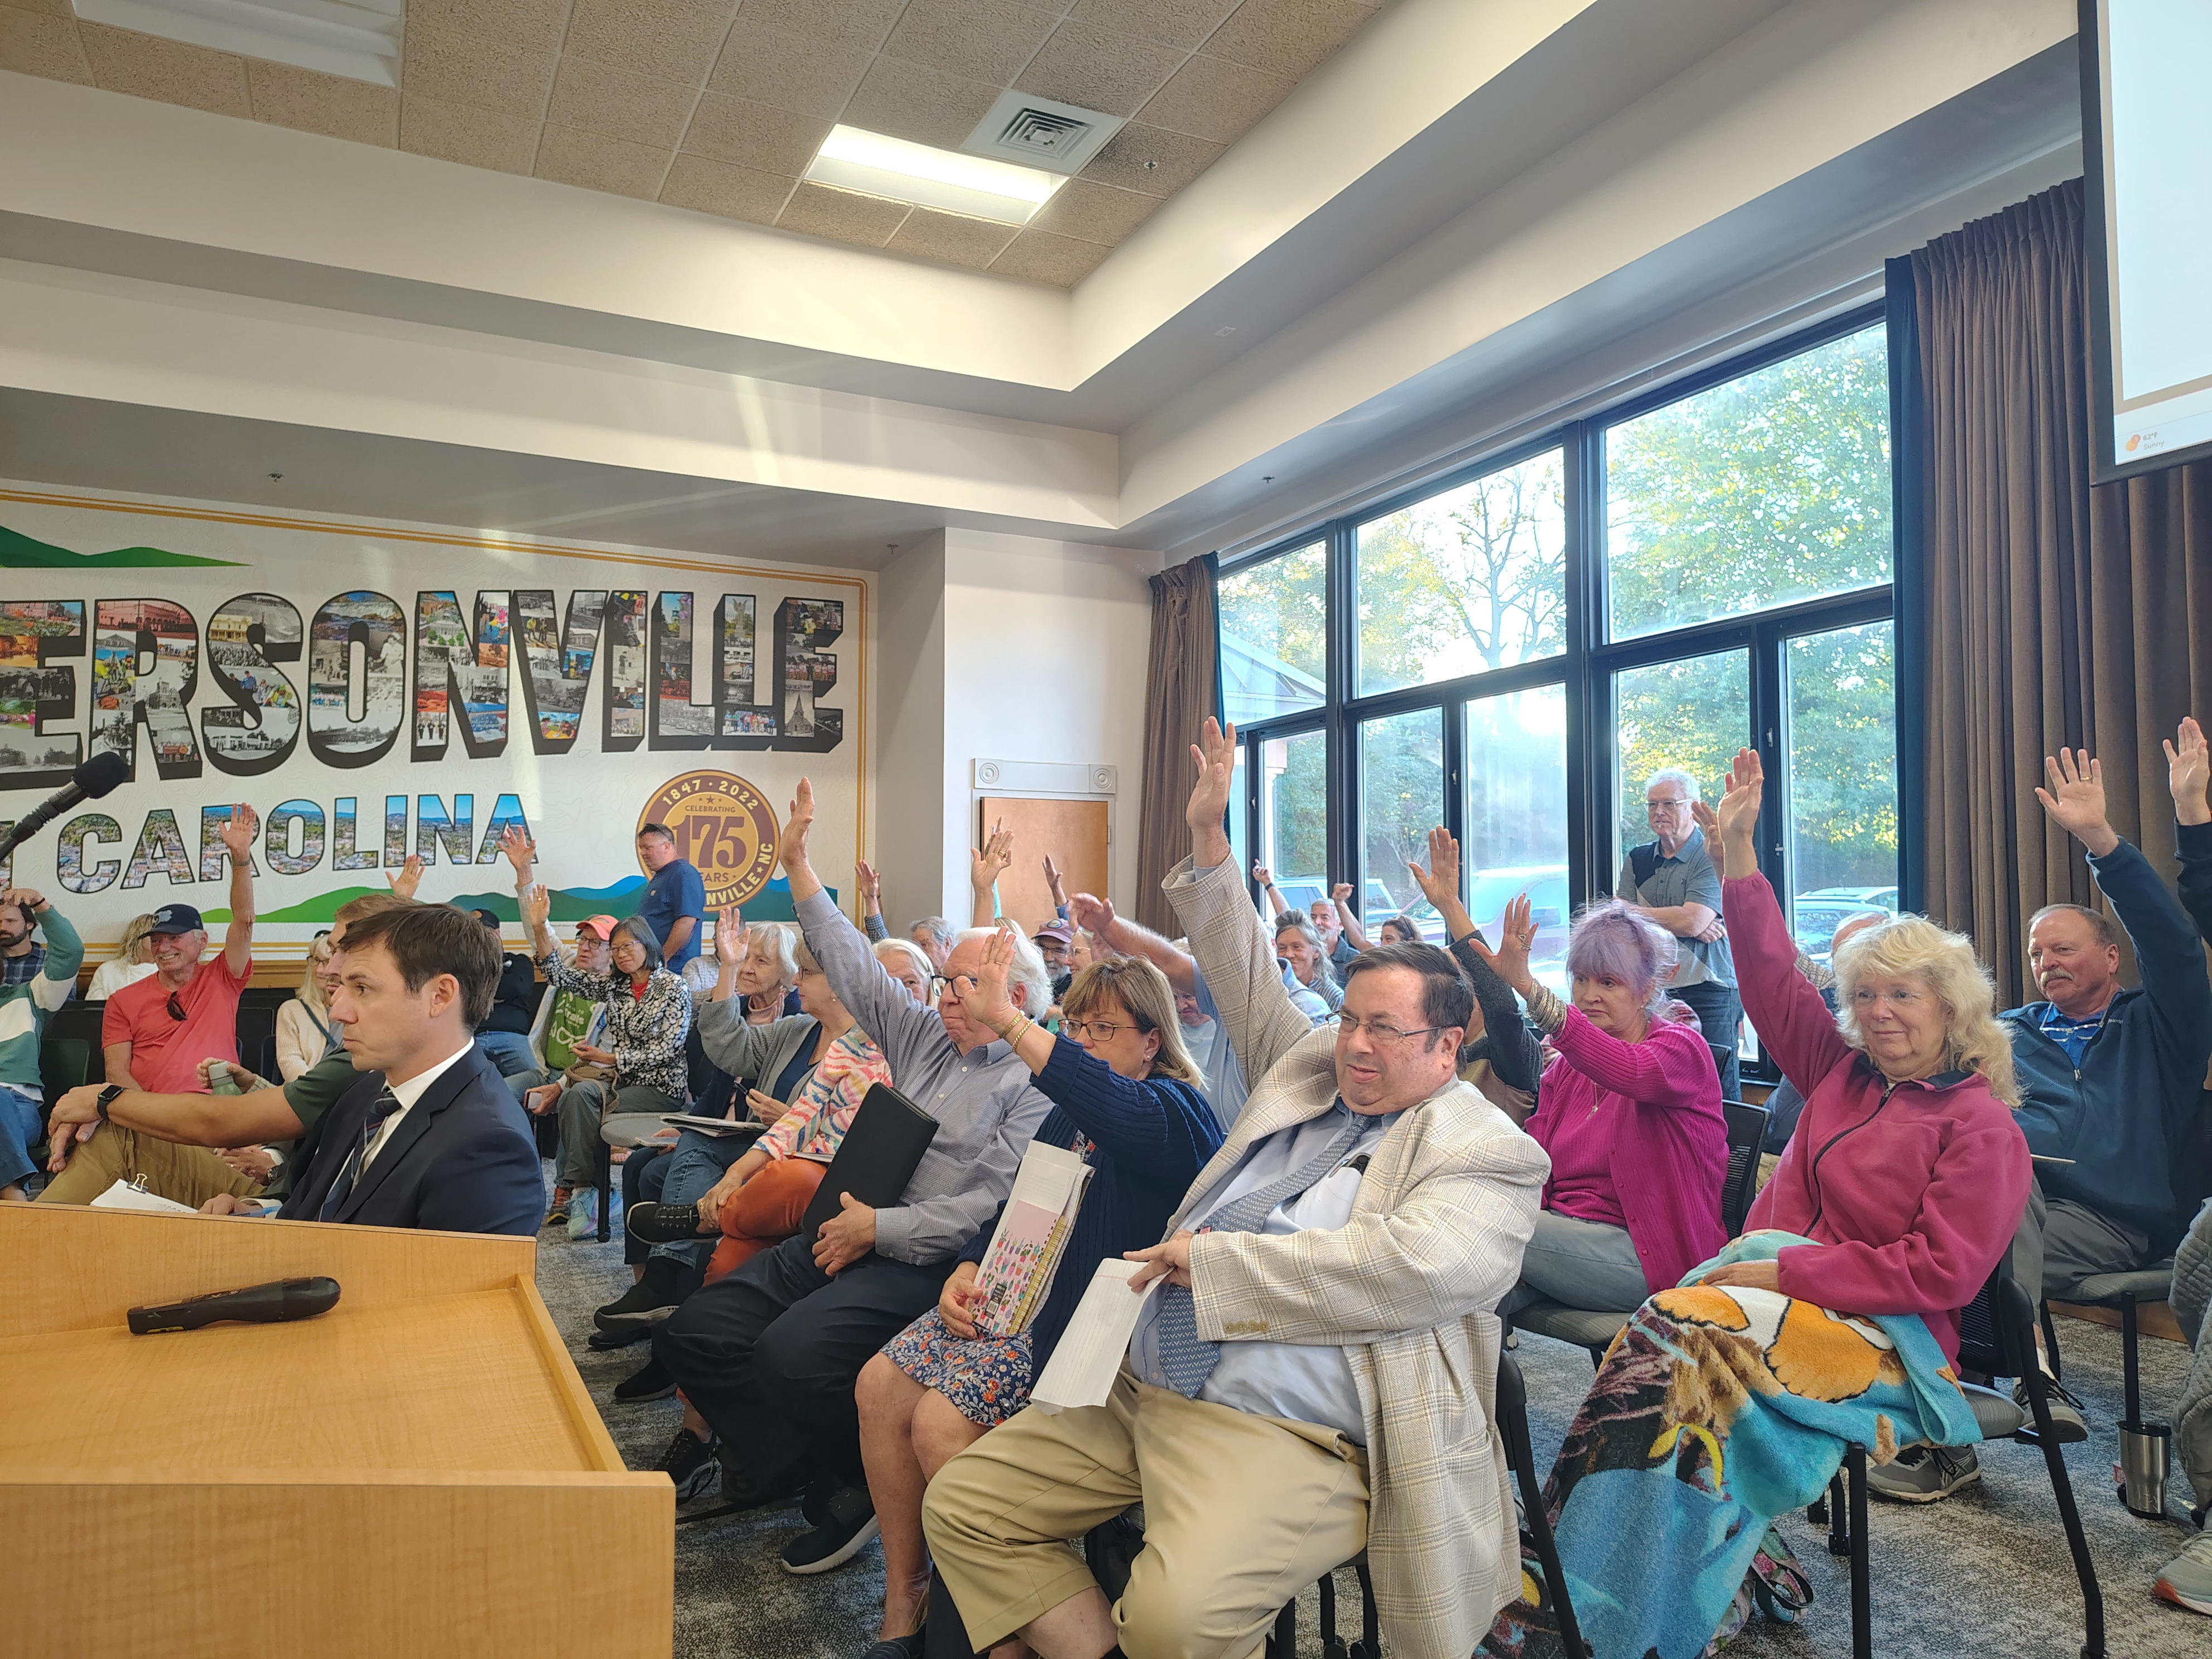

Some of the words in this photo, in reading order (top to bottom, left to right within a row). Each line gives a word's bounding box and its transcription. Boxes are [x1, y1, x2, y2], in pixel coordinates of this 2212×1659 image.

[2143, 441, 2165, 450] Sunny
[663, 779, 701, 806] 1847
[719, 780, 759, 811] 2022
[57, 793, 539, 894] CAROLINA
[672, 815, 747, 869] 175
[758, 843, 773, 865] NC
